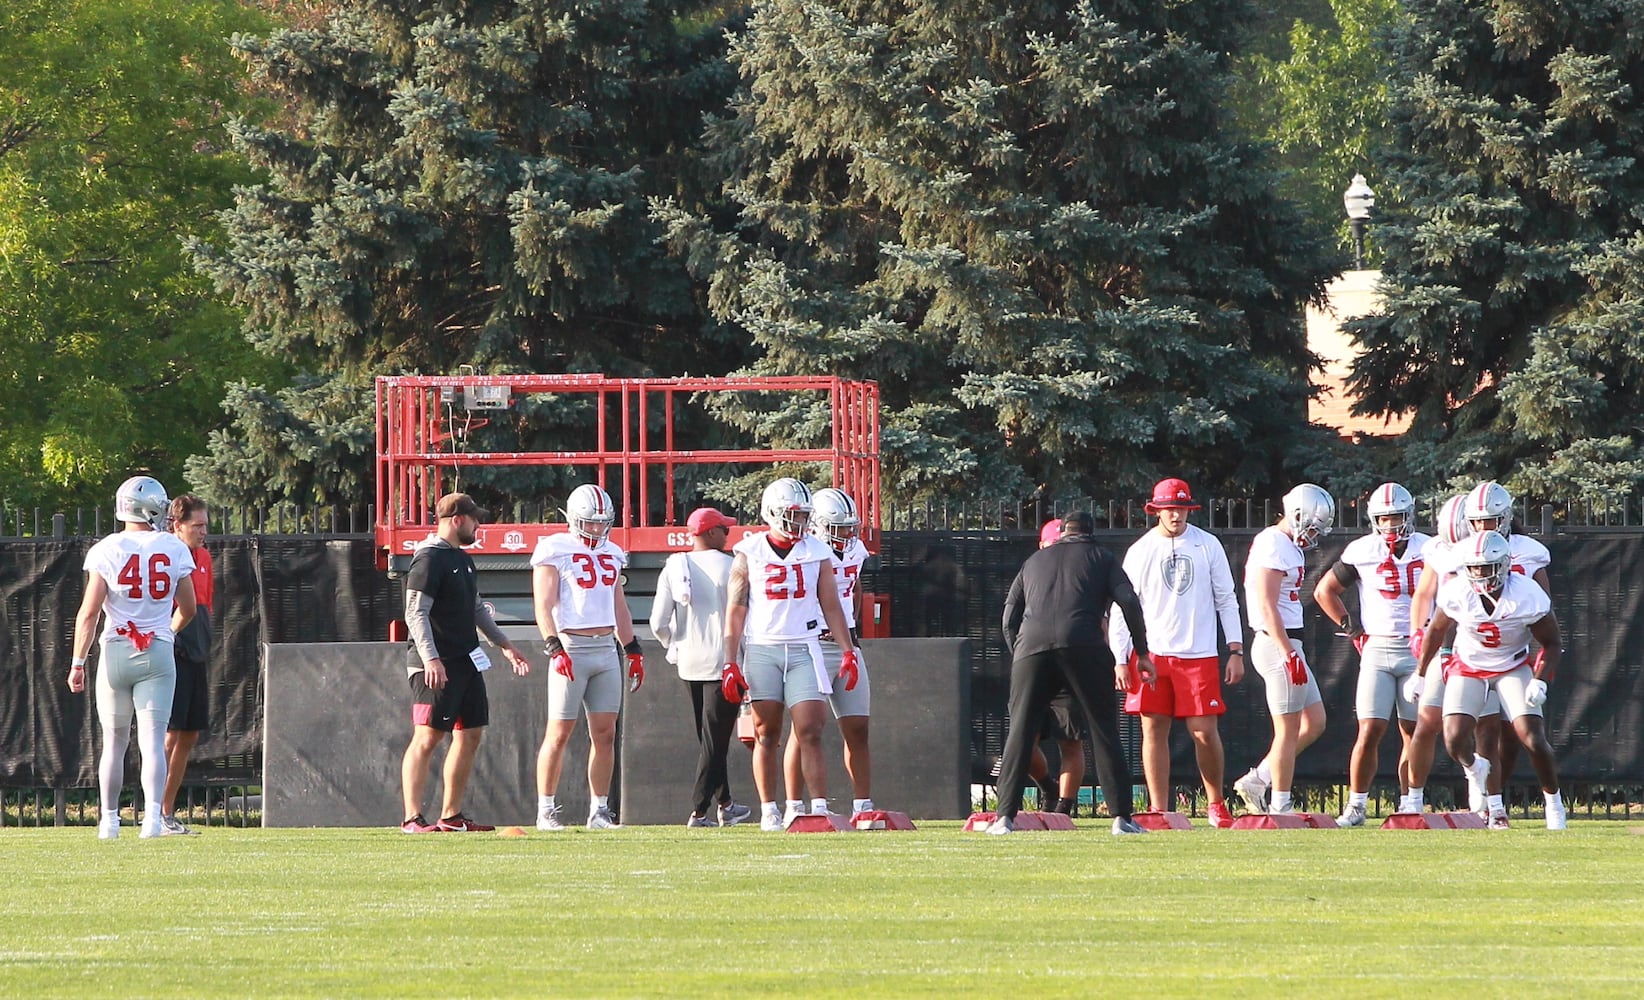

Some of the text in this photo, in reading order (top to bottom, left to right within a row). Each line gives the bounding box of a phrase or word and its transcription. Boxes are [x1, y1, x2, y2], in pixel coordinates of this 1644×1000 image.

[507, 534, 520, 545] 30
[117, 553, 171, 600] 46
[572, 553, 618, 589] 35
[764, 563, 807, 601] 21
[1376, 560, 1424, 600] 30
[1476, 621, 1502, 648] 3
